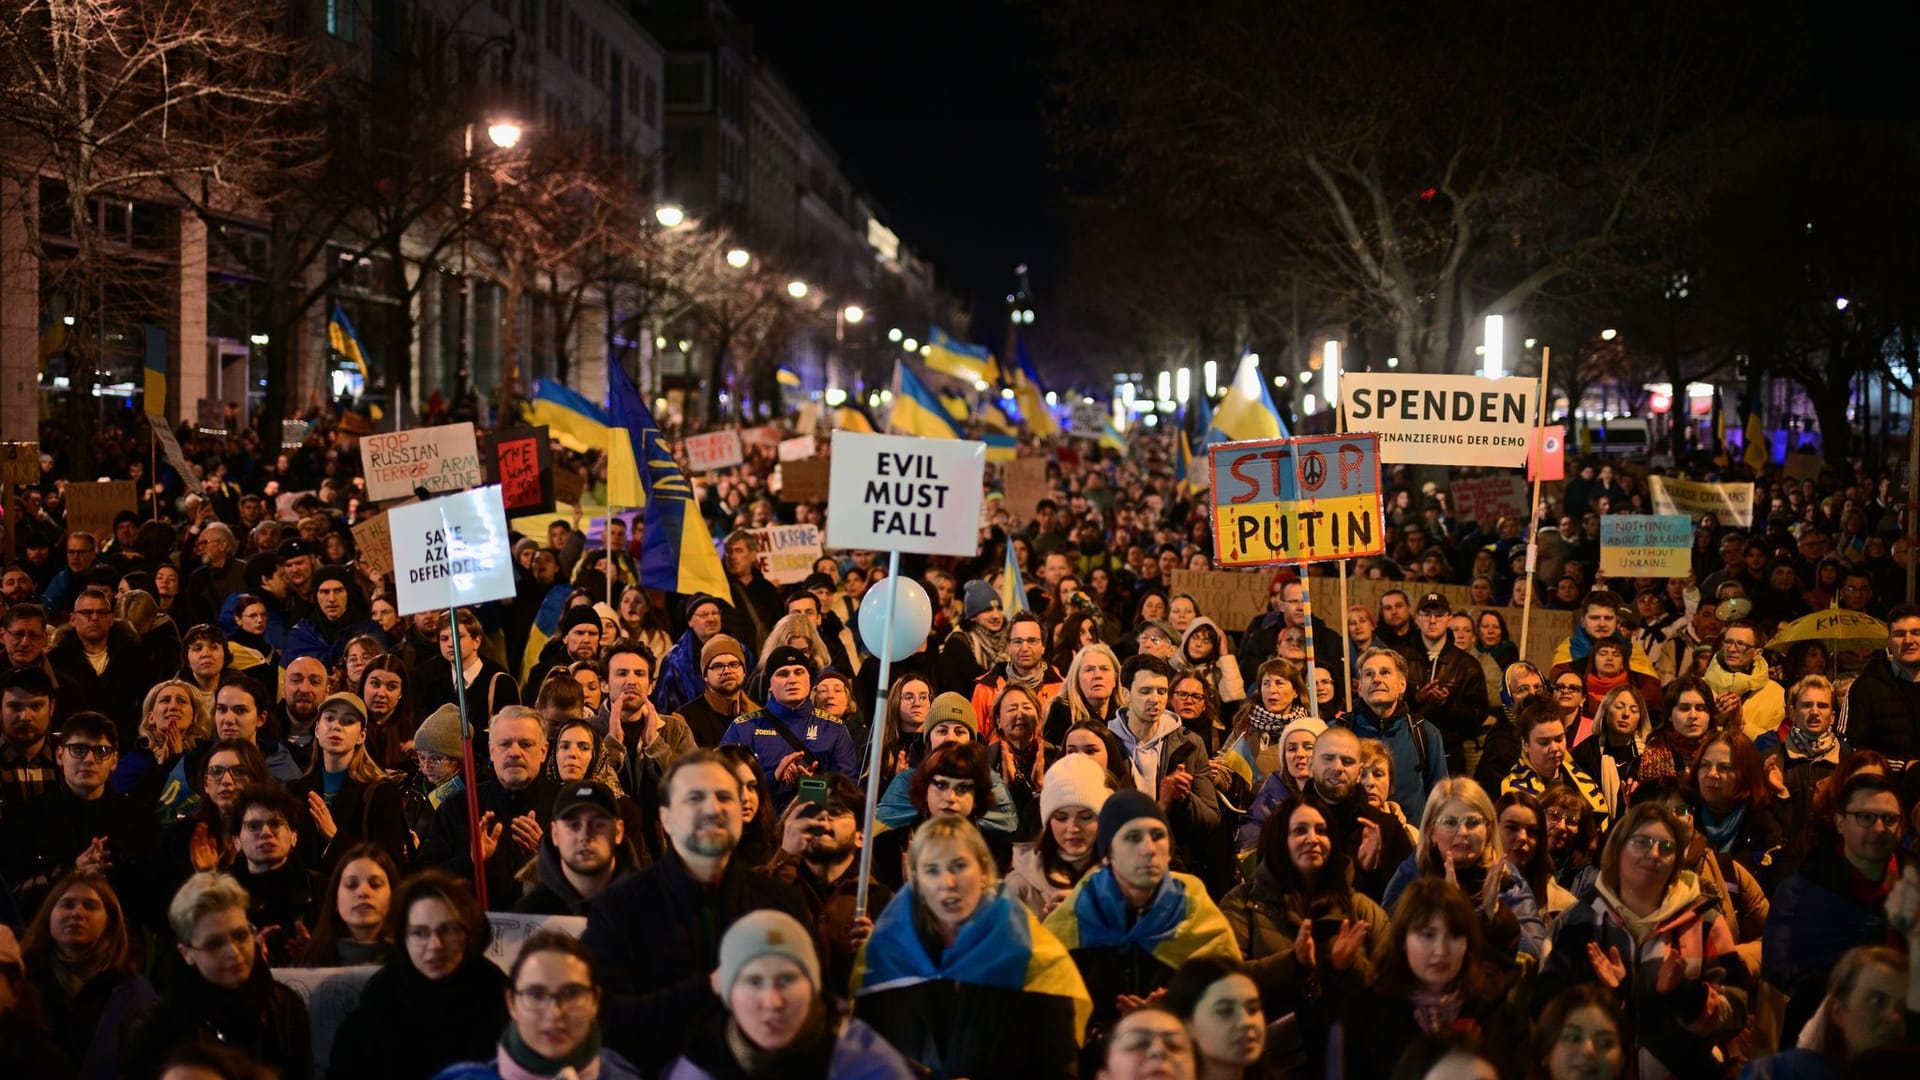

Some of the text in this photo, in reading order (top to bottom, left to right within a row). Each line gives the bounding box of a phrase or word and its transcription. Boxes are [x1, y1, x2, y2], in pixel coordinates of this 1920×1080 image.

[1352, 388, 1527, 424] SPENDEN
[368, 433, 410, 452] STOP
[1467, 435, 1489, 446] DER
[1493, 436, 1525, 447] DEMO
[370, 443, 440, 468] RUSSIAN
[440, 455, 479, 475] ARM
[499, 443, 532, 468] THE
[877, 452, 938, 480] EVIL
[373, 462, 429, 483] TERROR
[412, 470, 478, 493] UKRAINE
[1230, 444, 1364, 504] STOP
[864, 481, 949, 509] MUST
[355, 518, 385, 545] THE
[872, 511, 937, 537] FALL
[1238, 511, 1371, 554] PUTIN
[1615, 520, 1672, 534] NOTHING
[1607, 534, 1690, 546] ABOUT UKRAINE
[1619, 558, 1668, 569] UKRAINE
[1626, 549, 1675, 557] WITHOUT
